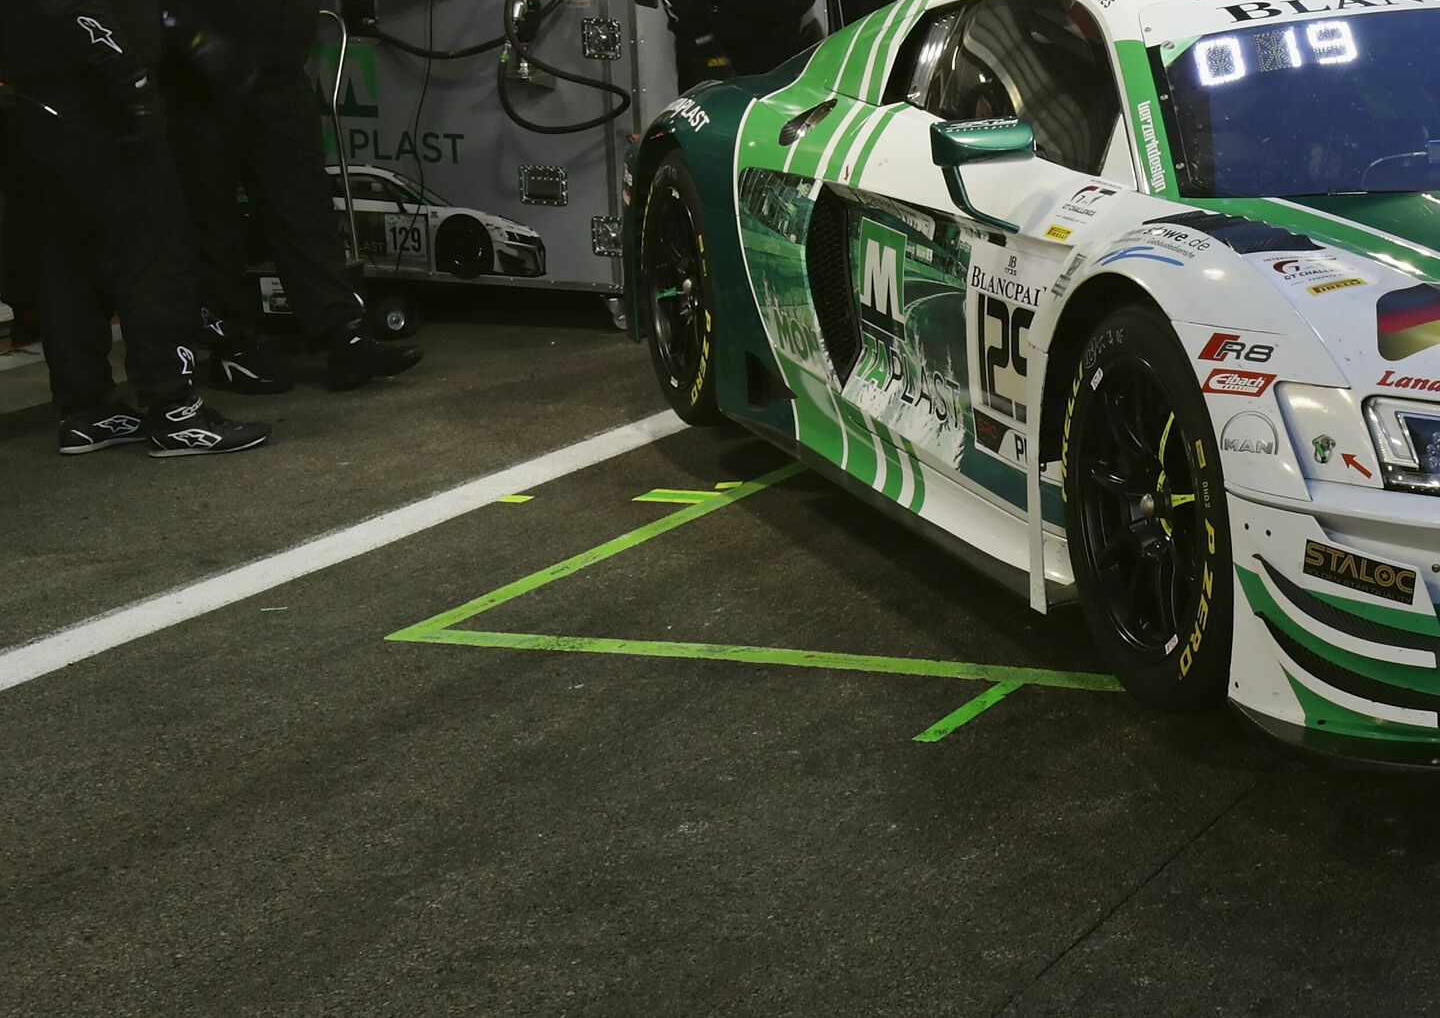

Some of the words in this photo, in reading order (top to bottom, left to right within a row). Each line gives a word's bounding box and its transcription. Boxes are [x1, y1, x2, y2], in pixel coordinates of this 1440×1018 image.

[1070, 203, 1097, 217] CHALLENGE
[390, 225, 422, 252] 129
[1048, 226, 1073, 241] PIRELLI
[1284, 273, 1298, 281] GT
[1299, 267, 1355, 278] CHALL
[970, 264, 1049, 308] BLANCPAI
[1312, 278, 1362, 294] PIRELLI
[1215, 340, 1275, 364] R8
[1208, 373, 1267, 390] Eibach
[1224, 437, 1274, 456] MAN
[1203, 517, 1216, 556] P
[1304, 542, 1416, 595] STALOC
[1178, 560, 1216, 682] ZERO
